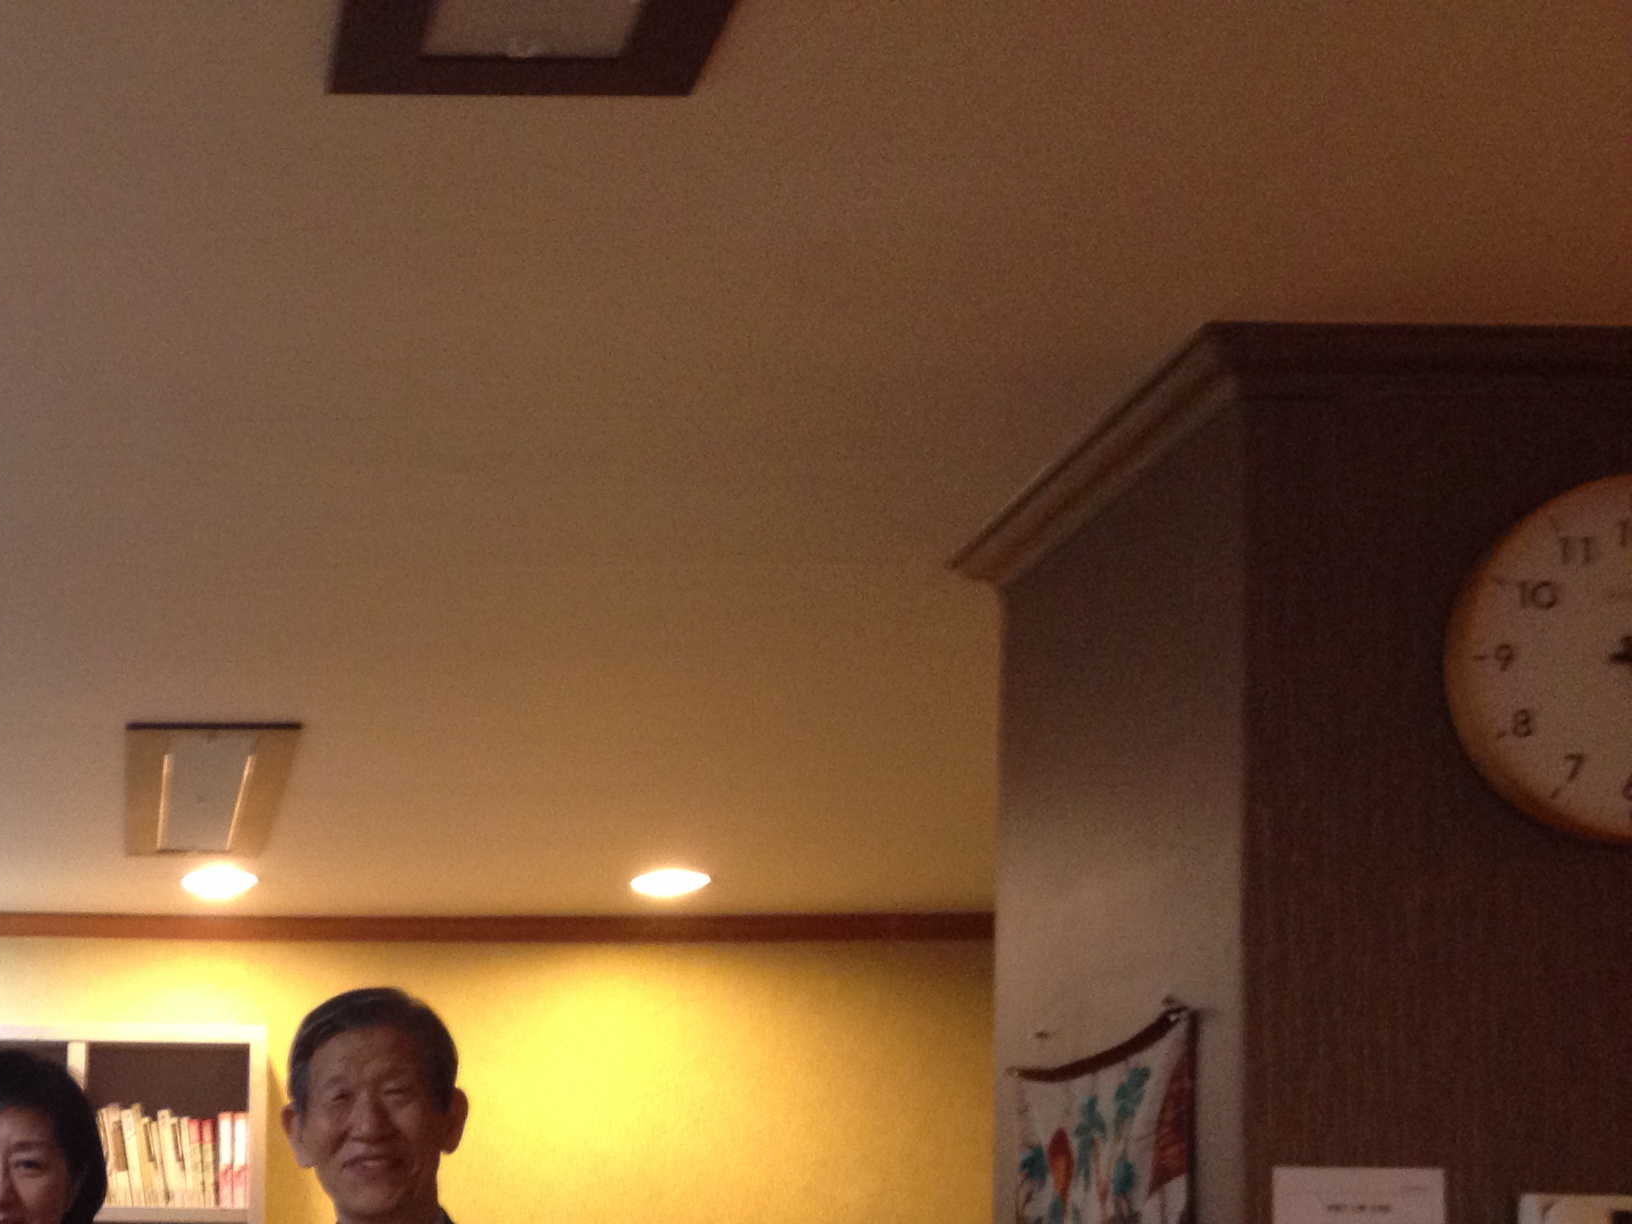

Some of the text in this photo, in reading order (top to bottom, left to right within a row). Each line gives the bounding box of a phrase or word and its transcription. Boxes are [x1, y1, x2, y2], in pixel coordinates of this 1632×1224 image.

[1560, 535, 1595, 566] 11
[1517, 579, 1558, 611] 10
[1494, 642, 1514, 672] 9
[1511, 708, 1533, 738] 8
[1564, 752, 1584, 782] 7
